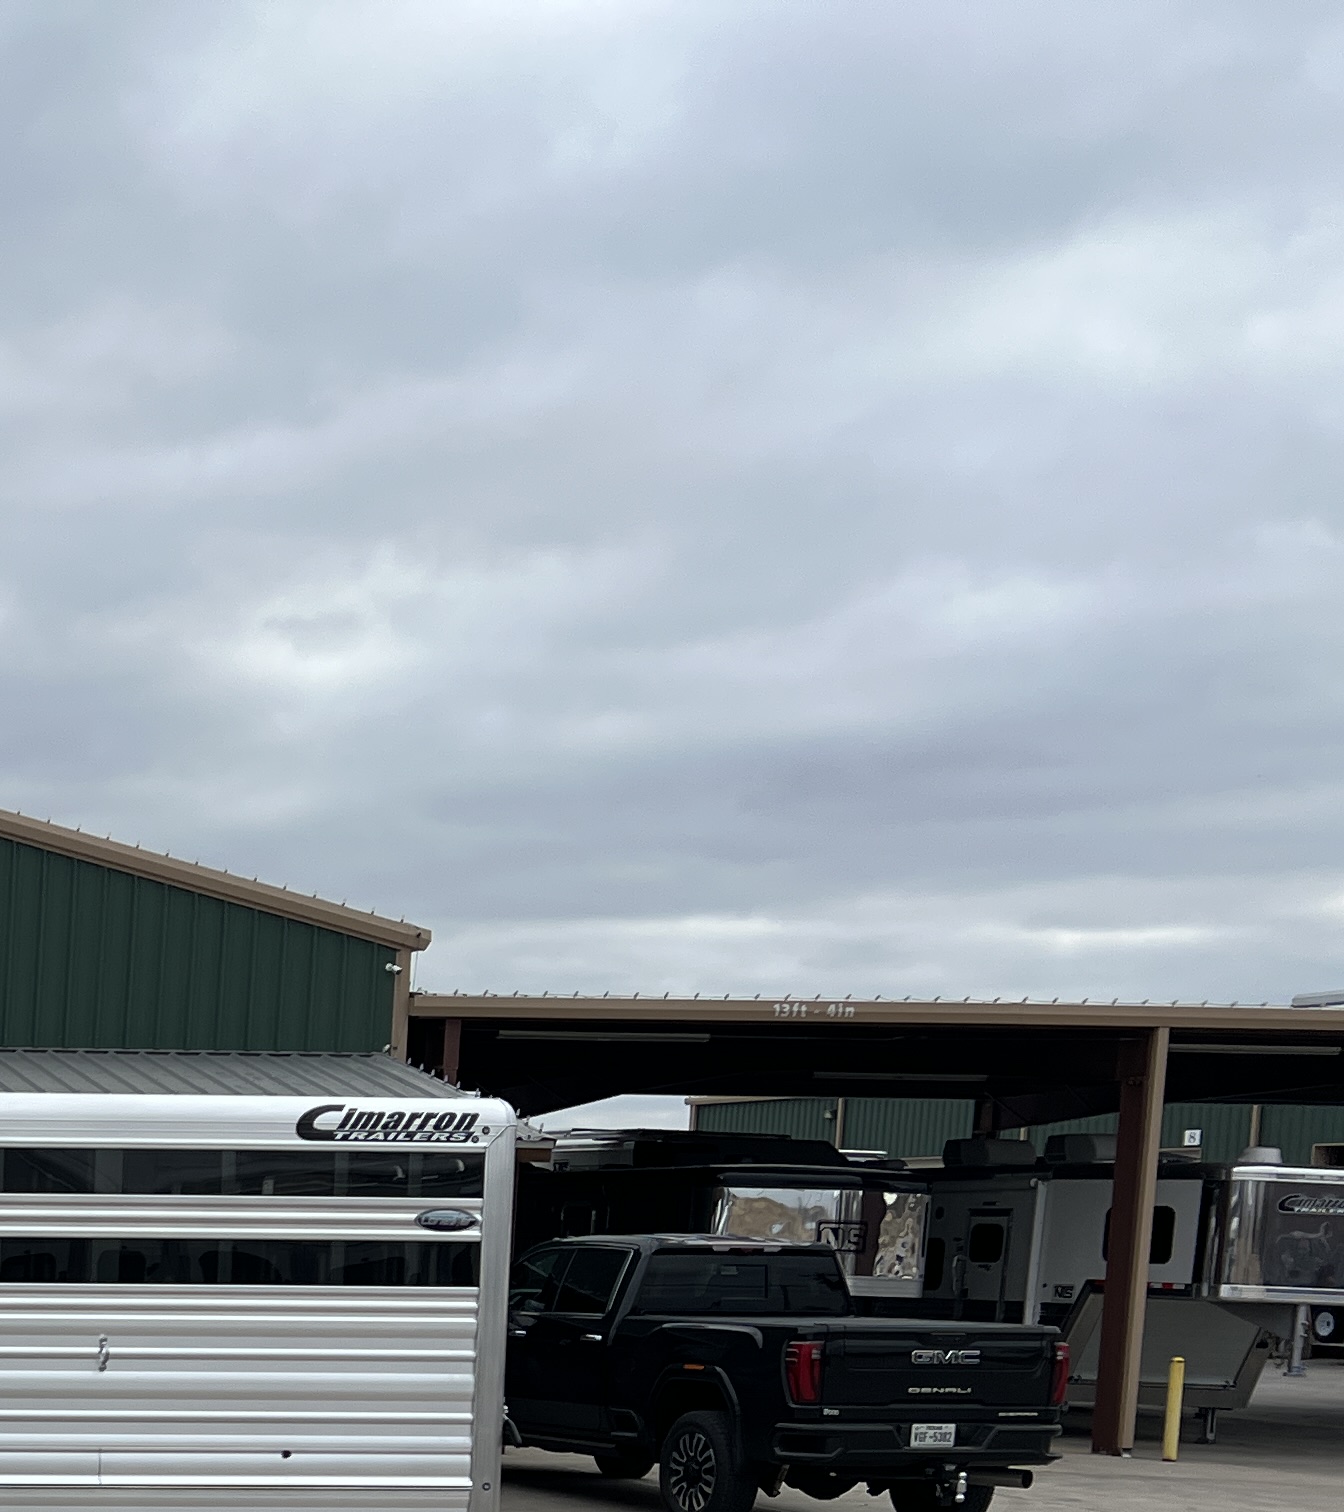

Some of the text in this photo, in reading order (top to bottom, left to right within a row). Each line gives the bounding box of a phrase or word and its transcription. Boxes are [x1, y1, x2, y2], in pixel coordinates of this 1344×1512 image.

[773, 1003, 808, 1018] 13ft
[296, 1104, 480, 1142] Cimarron
[333, 1131, 469, 1142] TRAILERS
[1187, 1131, 1197, 1144] 8
[912, 1350, 981, 1364] GMC
